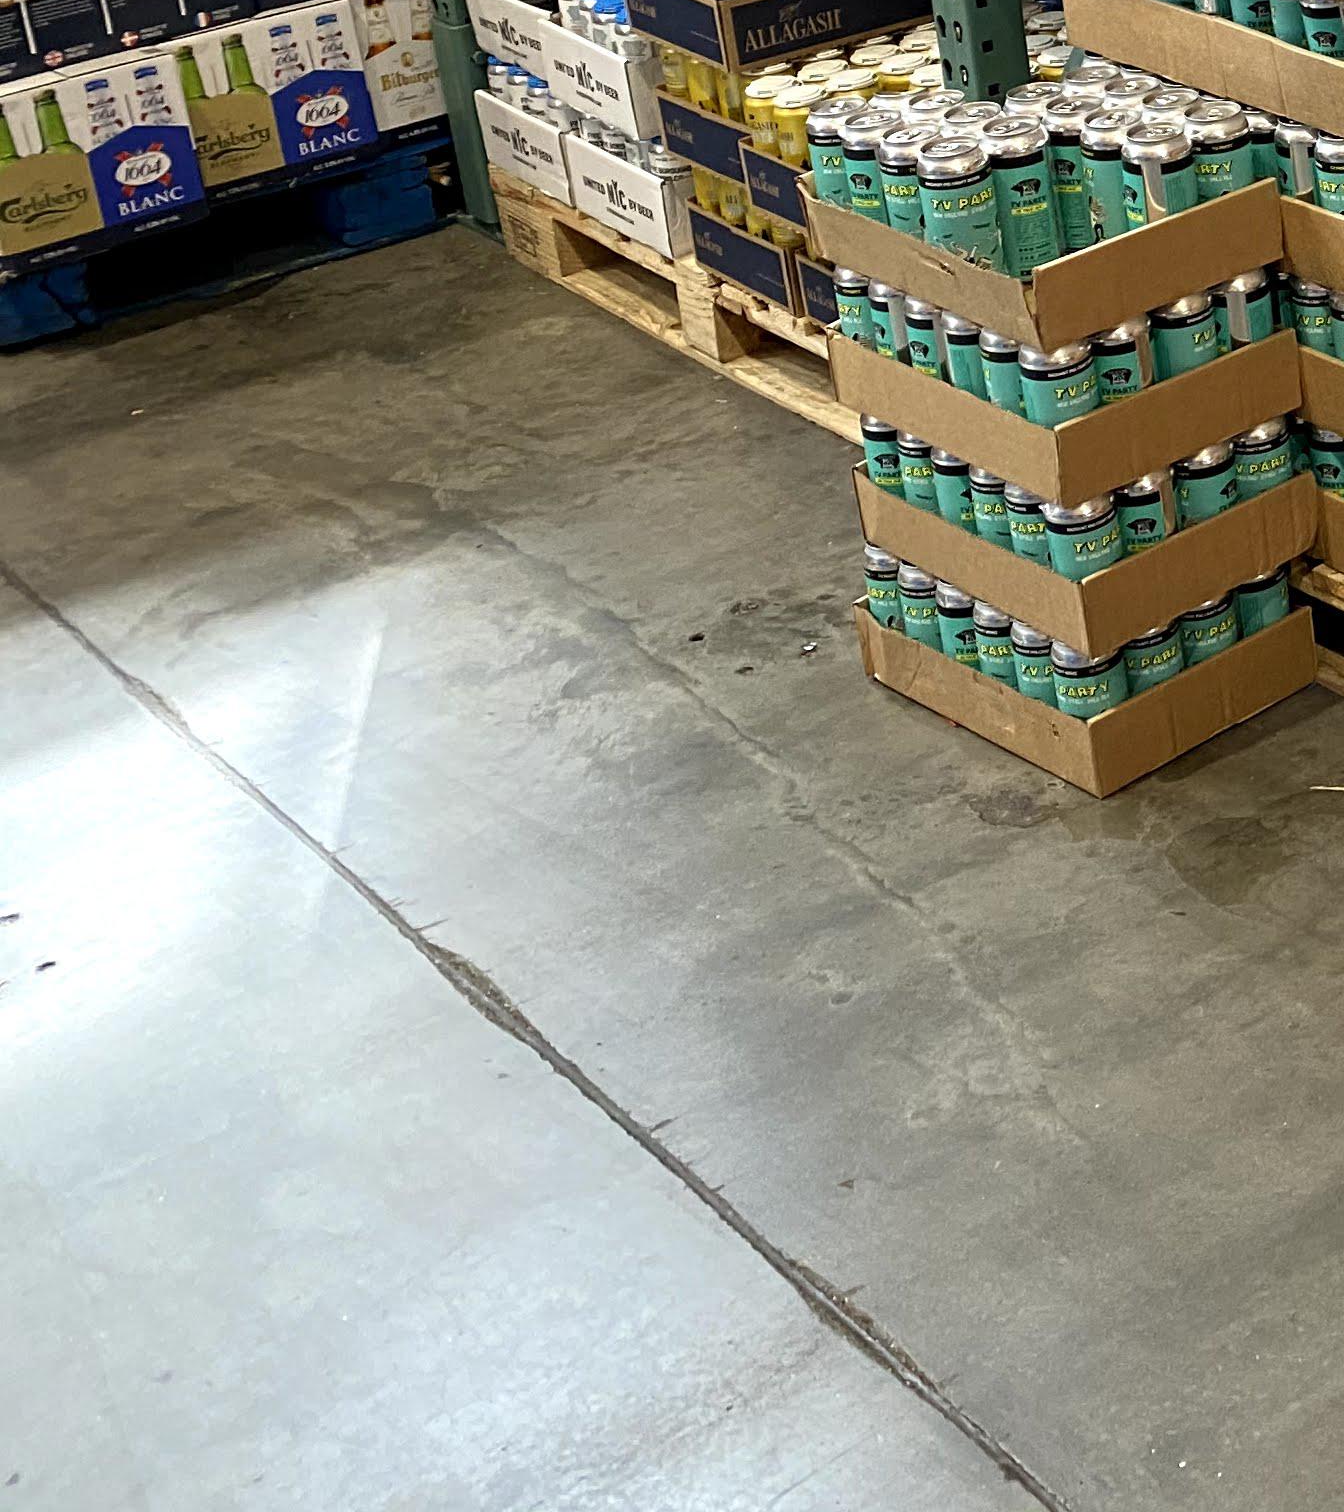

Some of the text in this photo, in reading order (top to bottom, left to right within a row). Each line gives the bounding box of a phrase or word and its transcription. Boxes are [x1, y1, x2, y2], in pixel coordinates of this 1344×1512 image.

[499, 18, 519, 46] NYC
[745, 9, 841, 53] ALLAGASH
[575, 61, 595, 92] NYC
[305, 103, 341, 124] 1664
[299, 128, 361, 156] BLANC
[511, 128, 529, 156] NYC
[125, 160, 161, 182] 1664
[822, 156, 841, 166] TV
[1, 184, 87, 224] Carlsberg
[118, 186, 184, 216] BLANC
[583, 176, 654, 221] UNITED NYC BY BEER
[932, 199, 952, 210] TV
[1059, 681, 1108, 696] PARTY
